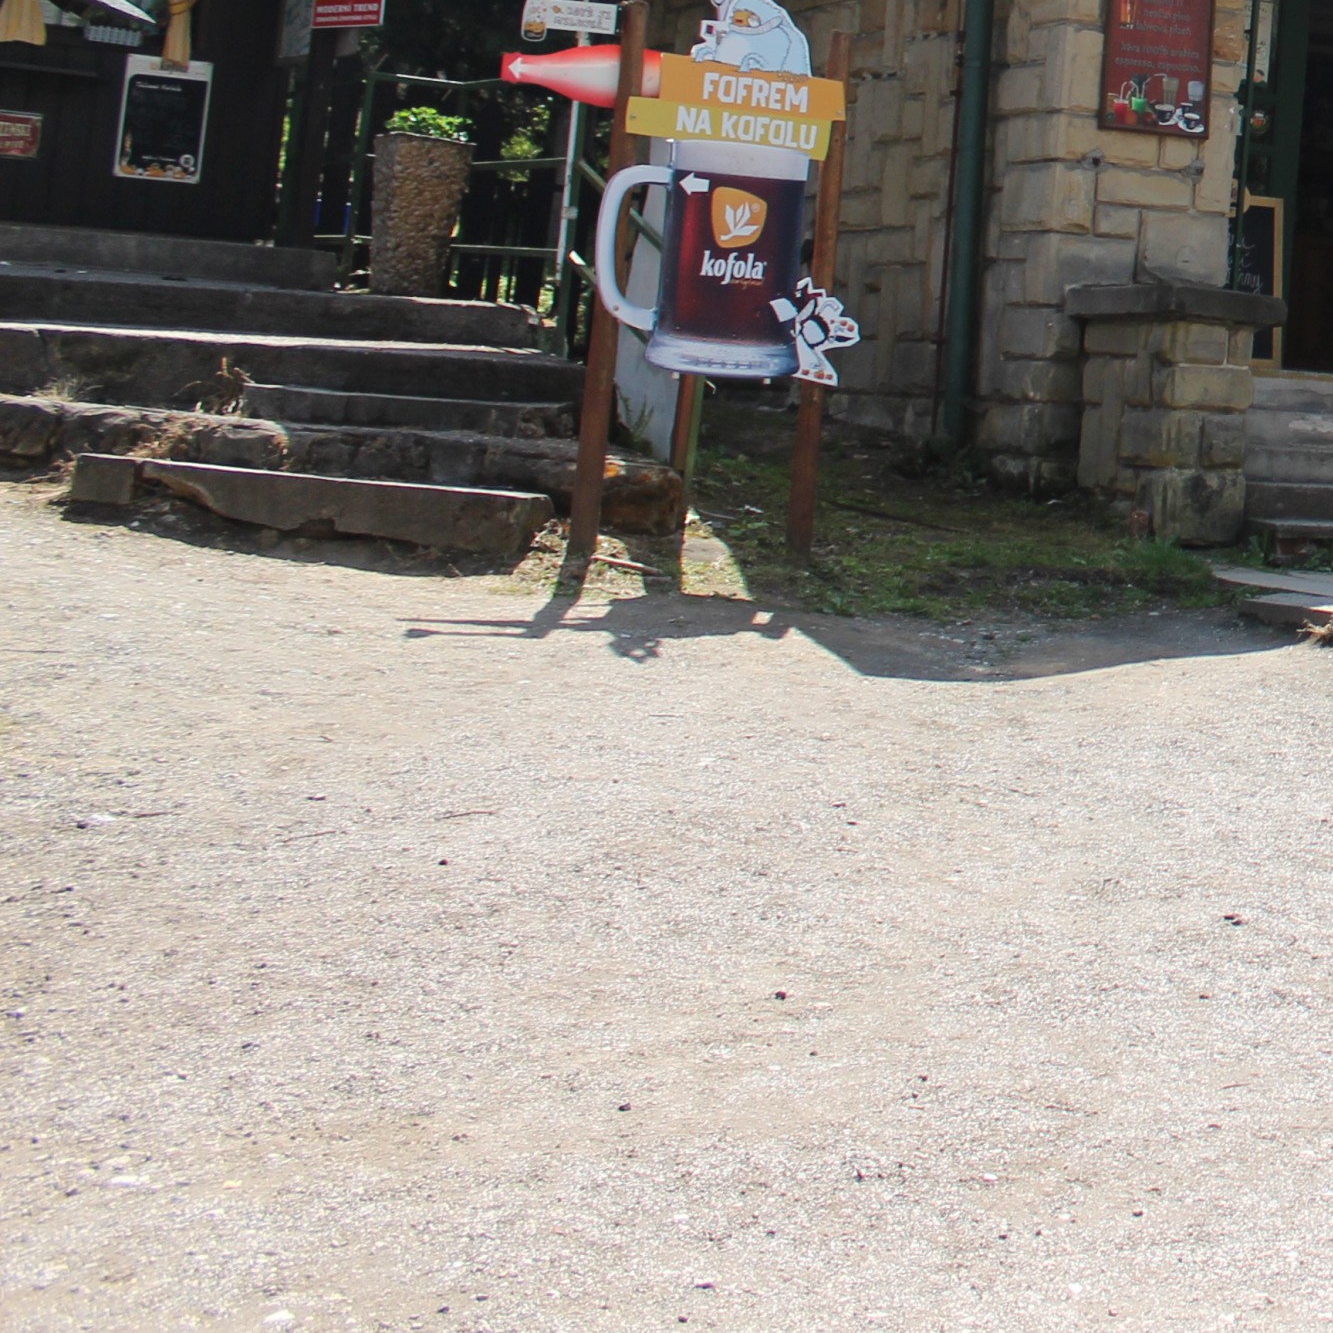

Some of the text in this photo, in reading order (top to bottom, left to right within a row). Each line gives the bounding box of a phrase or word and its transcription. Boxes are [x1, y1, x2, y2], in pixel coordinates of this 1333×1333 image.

[703, 71, 809, 113] FOFREM
[675, 105, 817, 150] NA KOFOLU
[700, 249, 764, 285] kofola
